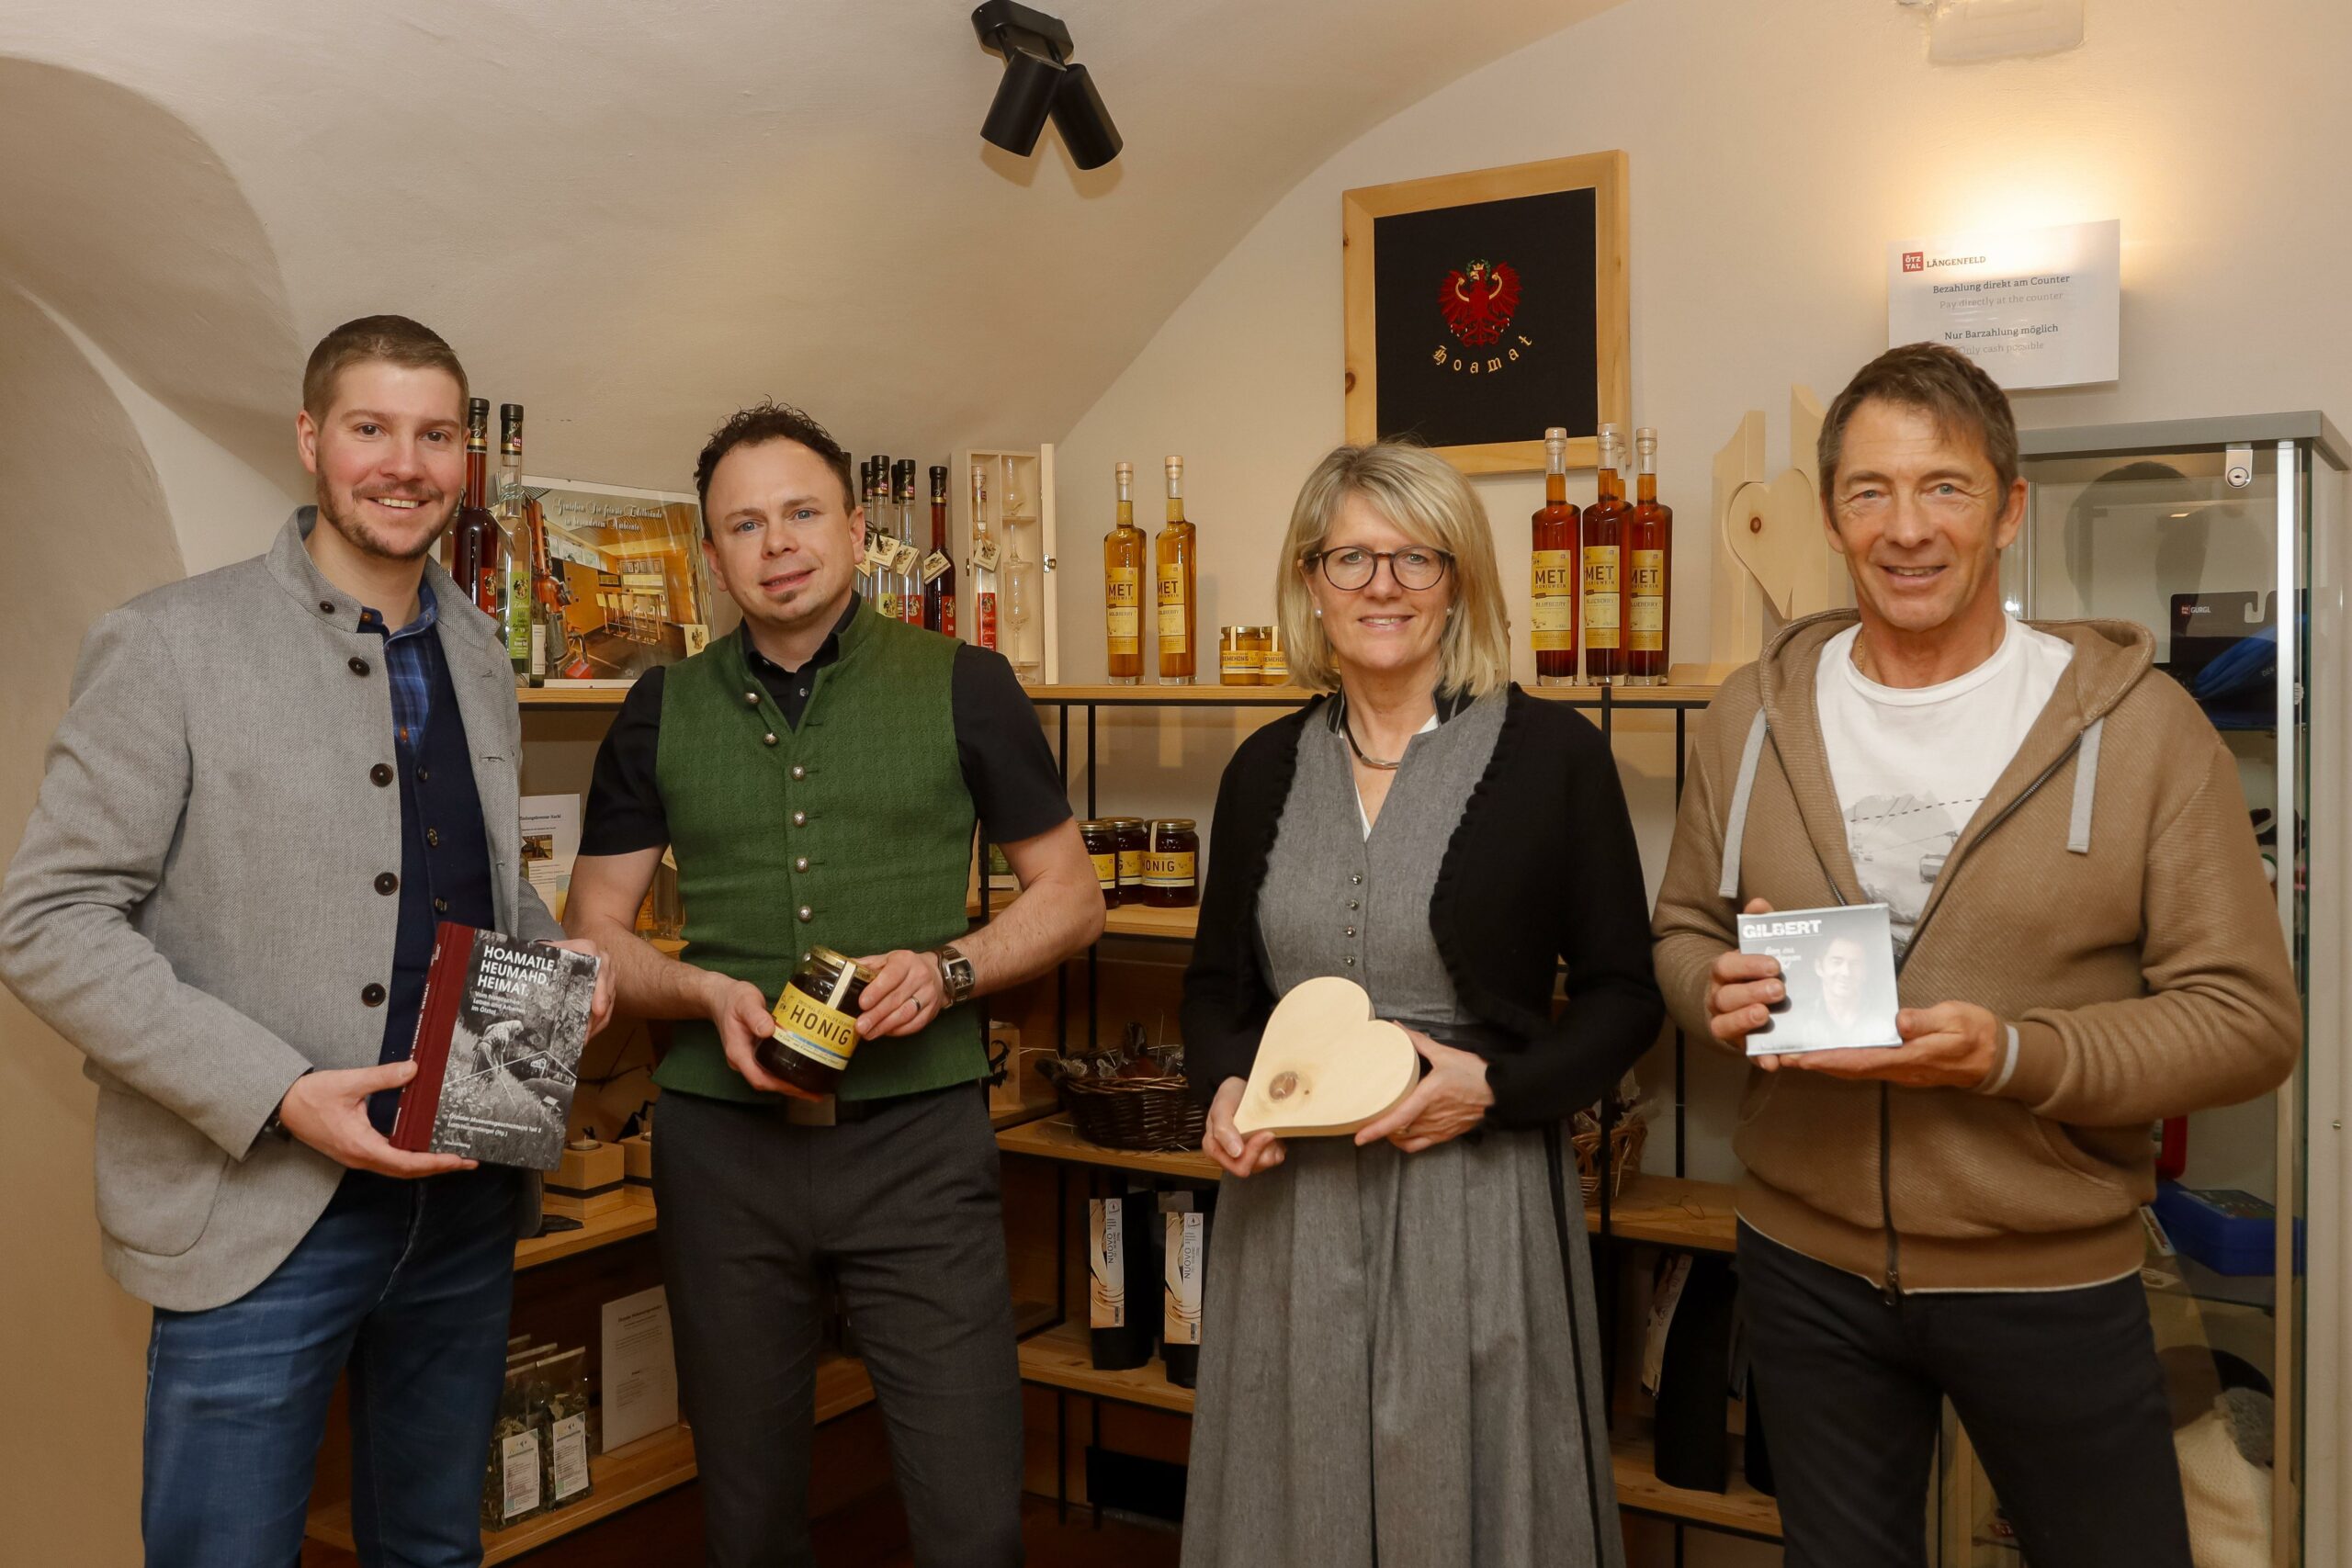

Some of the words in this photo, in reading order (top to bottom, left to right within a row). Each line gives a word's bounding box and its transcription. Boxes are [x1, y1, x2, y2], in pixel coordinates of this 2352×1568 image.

[1905, 254, 1921, 263] ÖTZ
[1927, 255, 1986, 268] LÄNGENFELD
[1933, 282, 1982, 294] Bezahlung
[1983, 279, 2011, 290] direkt
[2013, 279, 2029, 288] am
[2030, 275, 2070, 286] Counter
[1939, 300, 1957, 310] Pay
[1960, 297, 1994, 309] directly
[2008, 294, 2024, 304] the
[2026, 292, 2064, 302] counter
[1944, 331, 1962, 341] Nur
[1965, 327, 2018, 339] Barzahlung
[2020, 324, 2058, 337] möglich
[1432, 334, 1532, 373] Hoamat
[1959, 345, 1980, 355] Only
[1983, 343, 2004, 353] cash
[1535, 570, 1566, 584] MET
[1586, 566, 1614, 581] MET
[1108, 583, 1134, 596] MET
[1158, 581, 1179, 595] MET
[1742, 919, 1822, 938] GILBERT
[483, 944, 557, 972] HOAMATLE.
[481, 959, 549, 987] HEUMAHD.
[477, 974, 529, 997] HEIMAT.
[789, 1004, 852, 1046] HONIG
[1183, 1247, 1192, 1280] NUOVO
